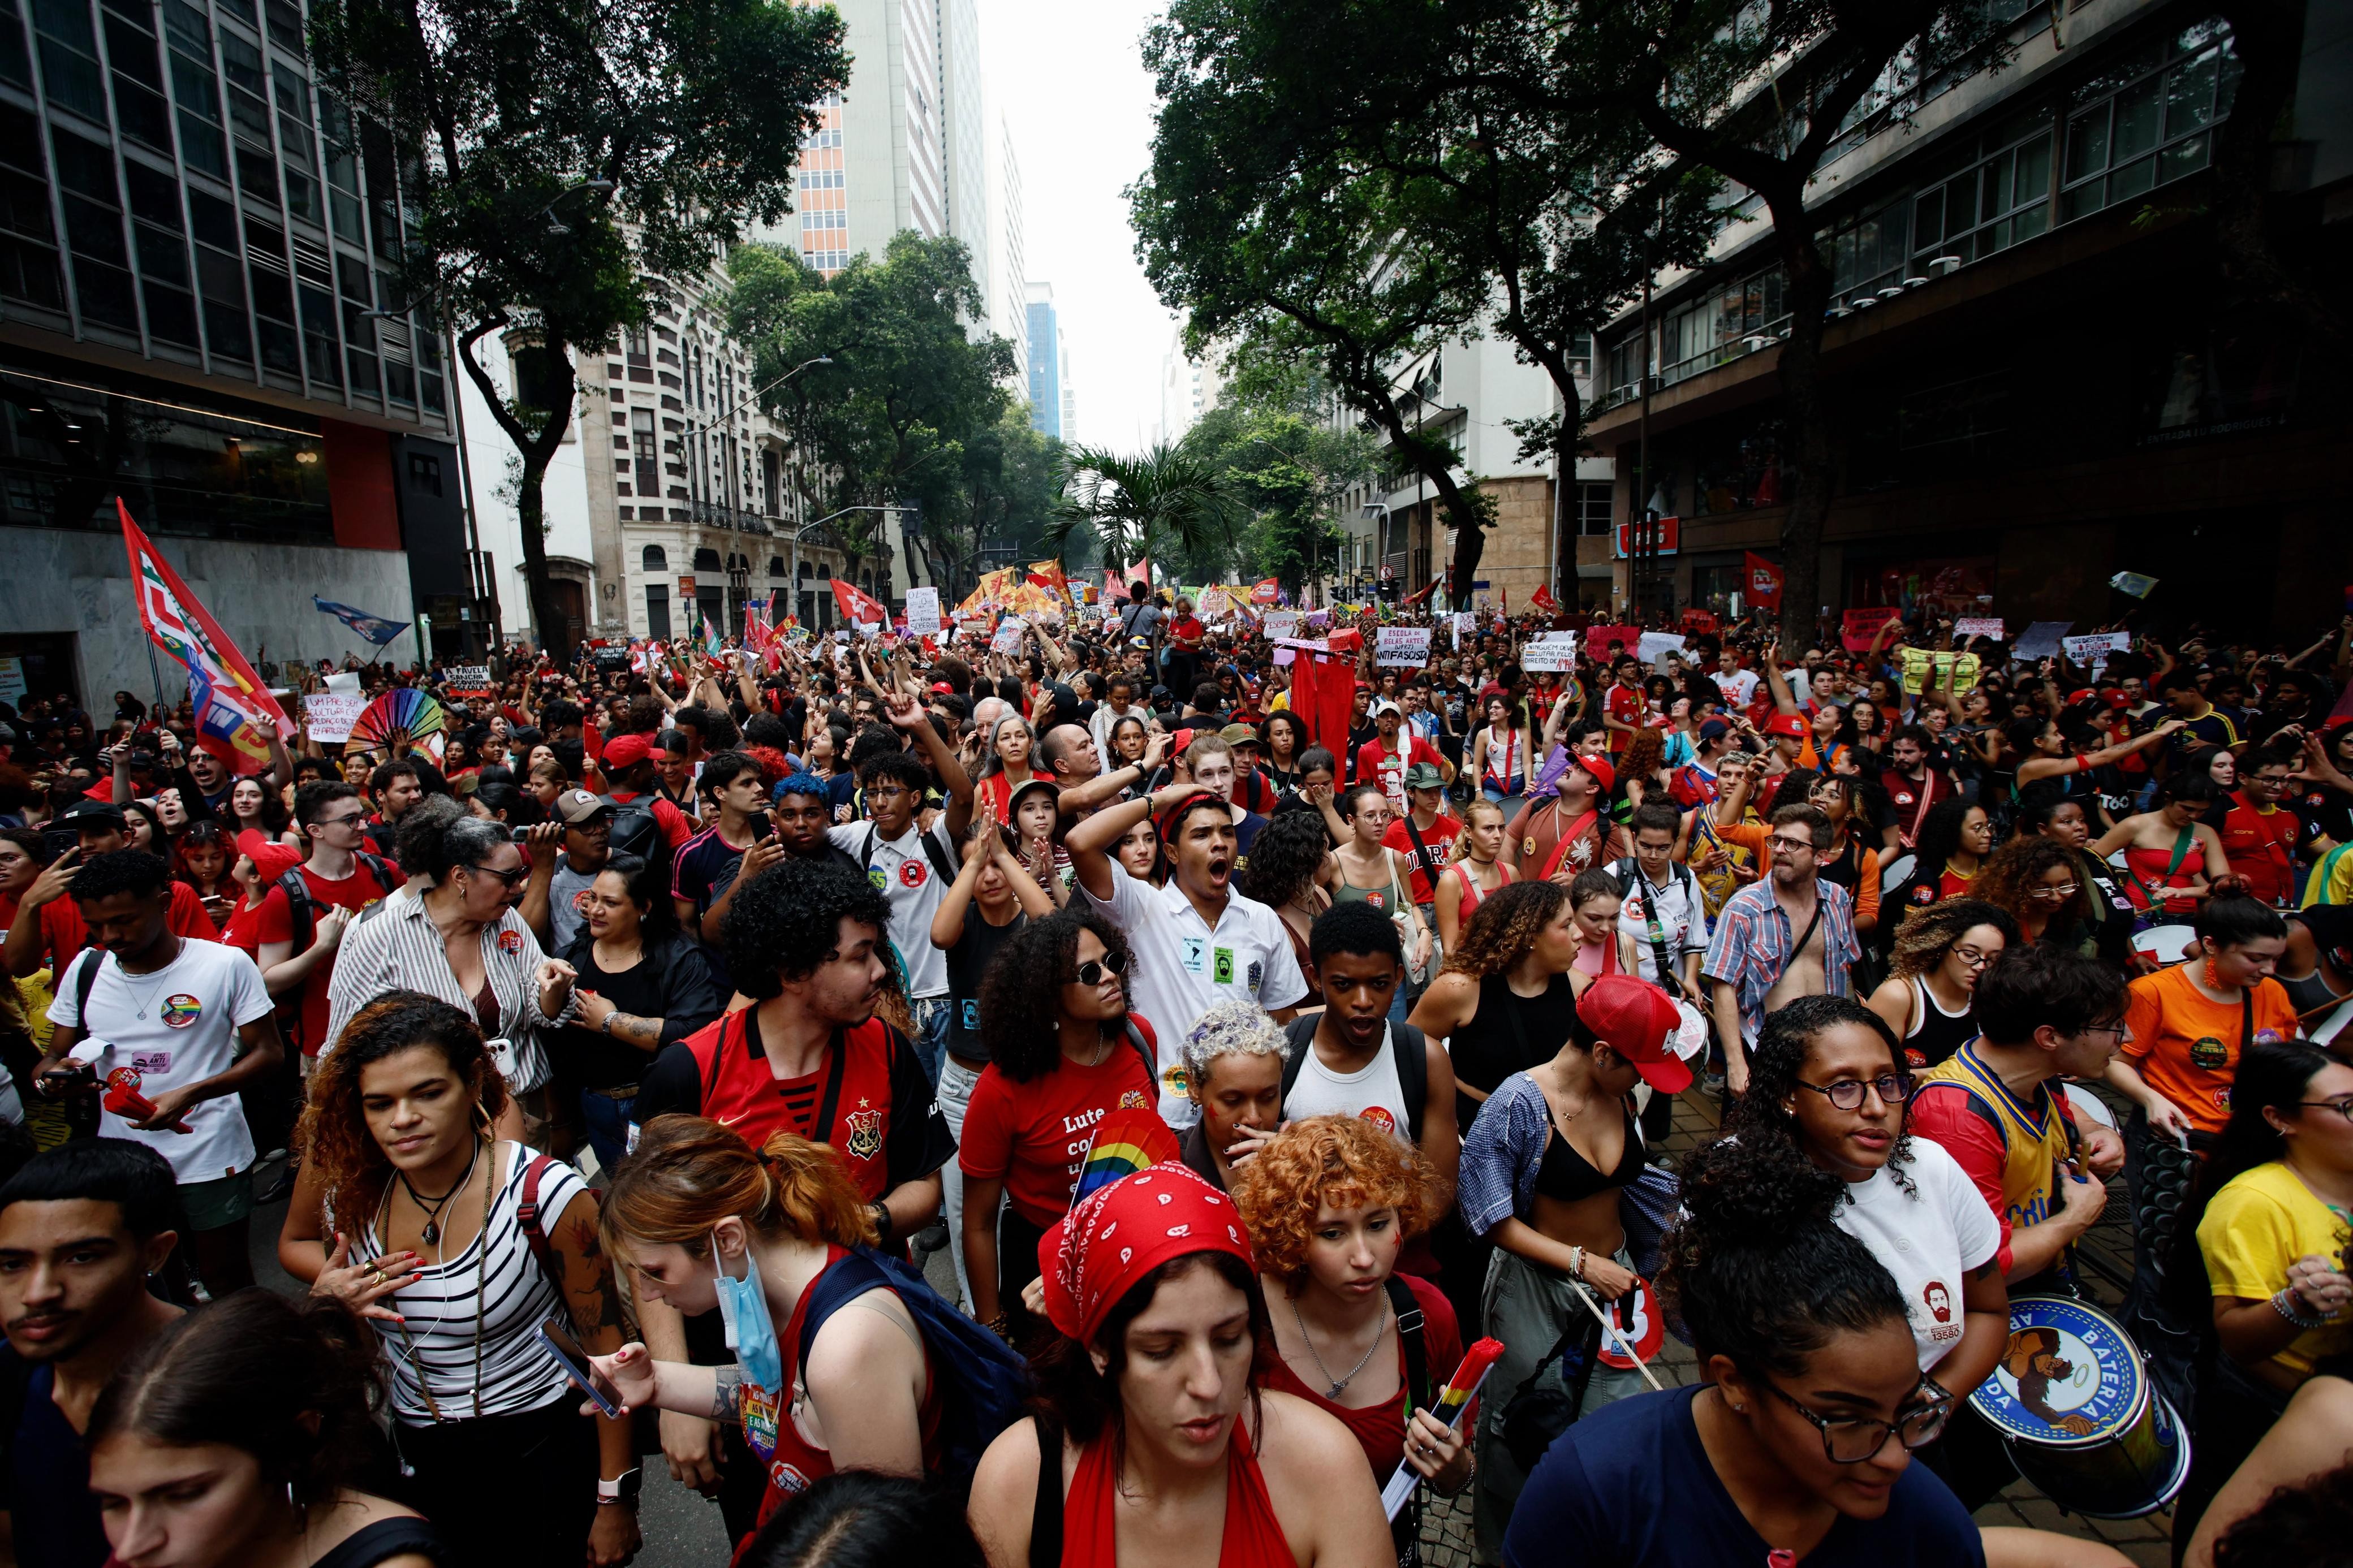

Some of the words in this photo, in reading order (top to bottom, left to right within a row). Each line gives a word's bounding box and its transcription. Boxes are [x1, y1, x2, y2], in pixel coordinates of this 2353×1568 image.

[1377, 651, 1427, 661] ANTIFASCISTA
[1556, 658, 1574, 671] AMAR
[309, 697, 324, 707] UM
[345, 698, 359, 708] SEM
[309, 707, 344, 718] CULTURA
[311, 717, 340, 725] PEDAÇO
[1063, 1107, 1106, 1134] Lute
[1932, 1329, 1959, 1341] 13580
[2080, 1329, 2117, 1417] BATERIA
[752, 1404, 758, 1413] AS
[759, 1406, 774, 1420] MNAS
[749, 1416, 753, 1426] E
[754, 1418, 761, 1428] AS
